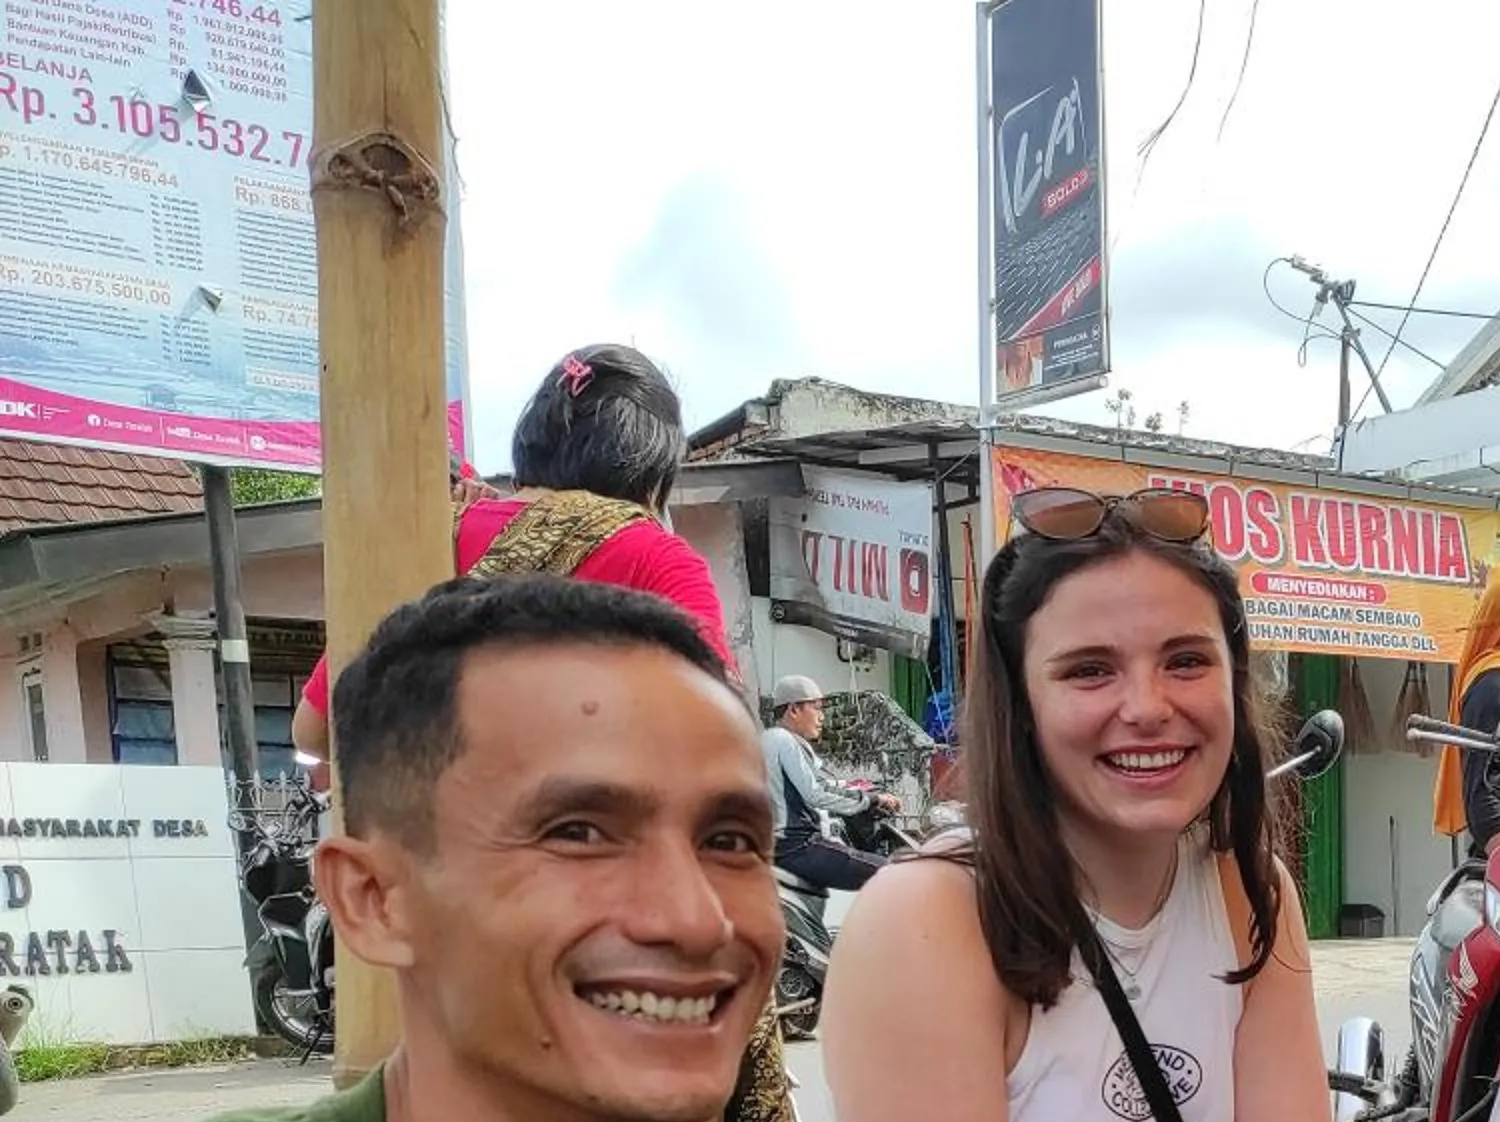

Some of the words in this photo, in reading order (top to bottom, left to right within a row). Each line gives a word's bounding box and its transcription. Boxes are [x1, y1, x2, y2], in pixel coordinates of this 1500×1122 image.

[73, 87, 313, 168] 3.105.532.7
[1292, 497, 1468, 579] KURNIA
[1298, 604, 1351, 622] MACAM
[1355, 609, 1421, 628] SEMBAKO
[1298, 627, 1350, 644] RUMAH
[1355, 632, 1409, 649] TANGGA
[1412, 637, 1437, 651] DLL
[0, 818, 141, 838] ASYARAKAT
[153, 819, 209, 838] DESA
